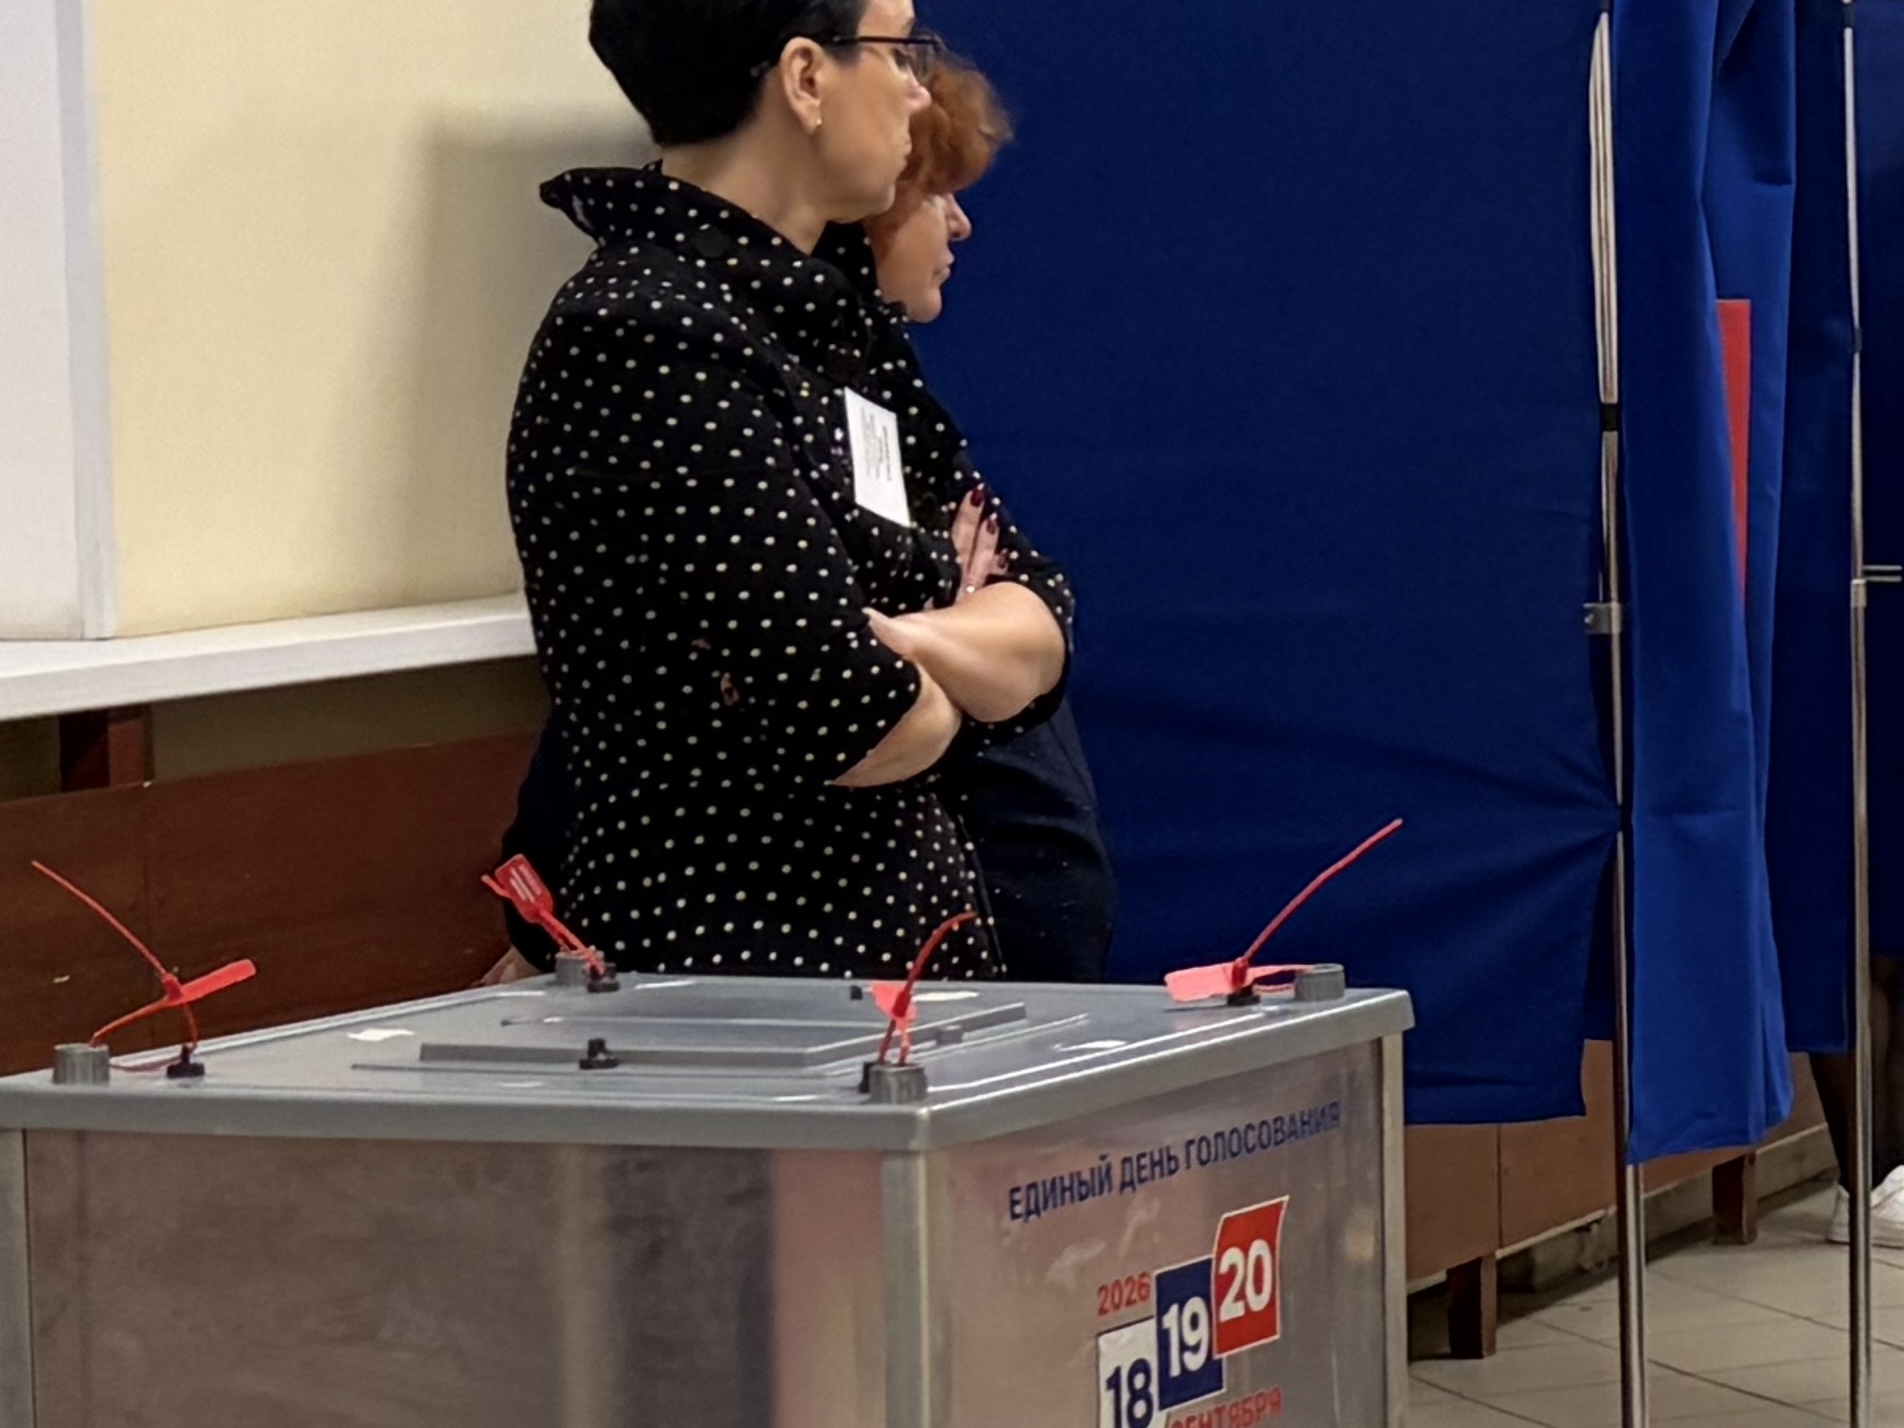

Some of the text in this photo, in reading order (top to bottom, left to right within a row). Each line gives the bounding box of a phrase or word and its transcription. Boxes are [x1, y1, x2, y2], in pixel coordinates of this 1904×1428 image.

[1008, 1099, 1342, 1224] ЕДИНЫЙ ДЕНЬ ГОЛОСОВАНИЯ
[1097, 1271, 1151, 1317] 2026
[1218, 1238, 1273, 1323] 20
[1161, 1295, 1210, 1378] 19
